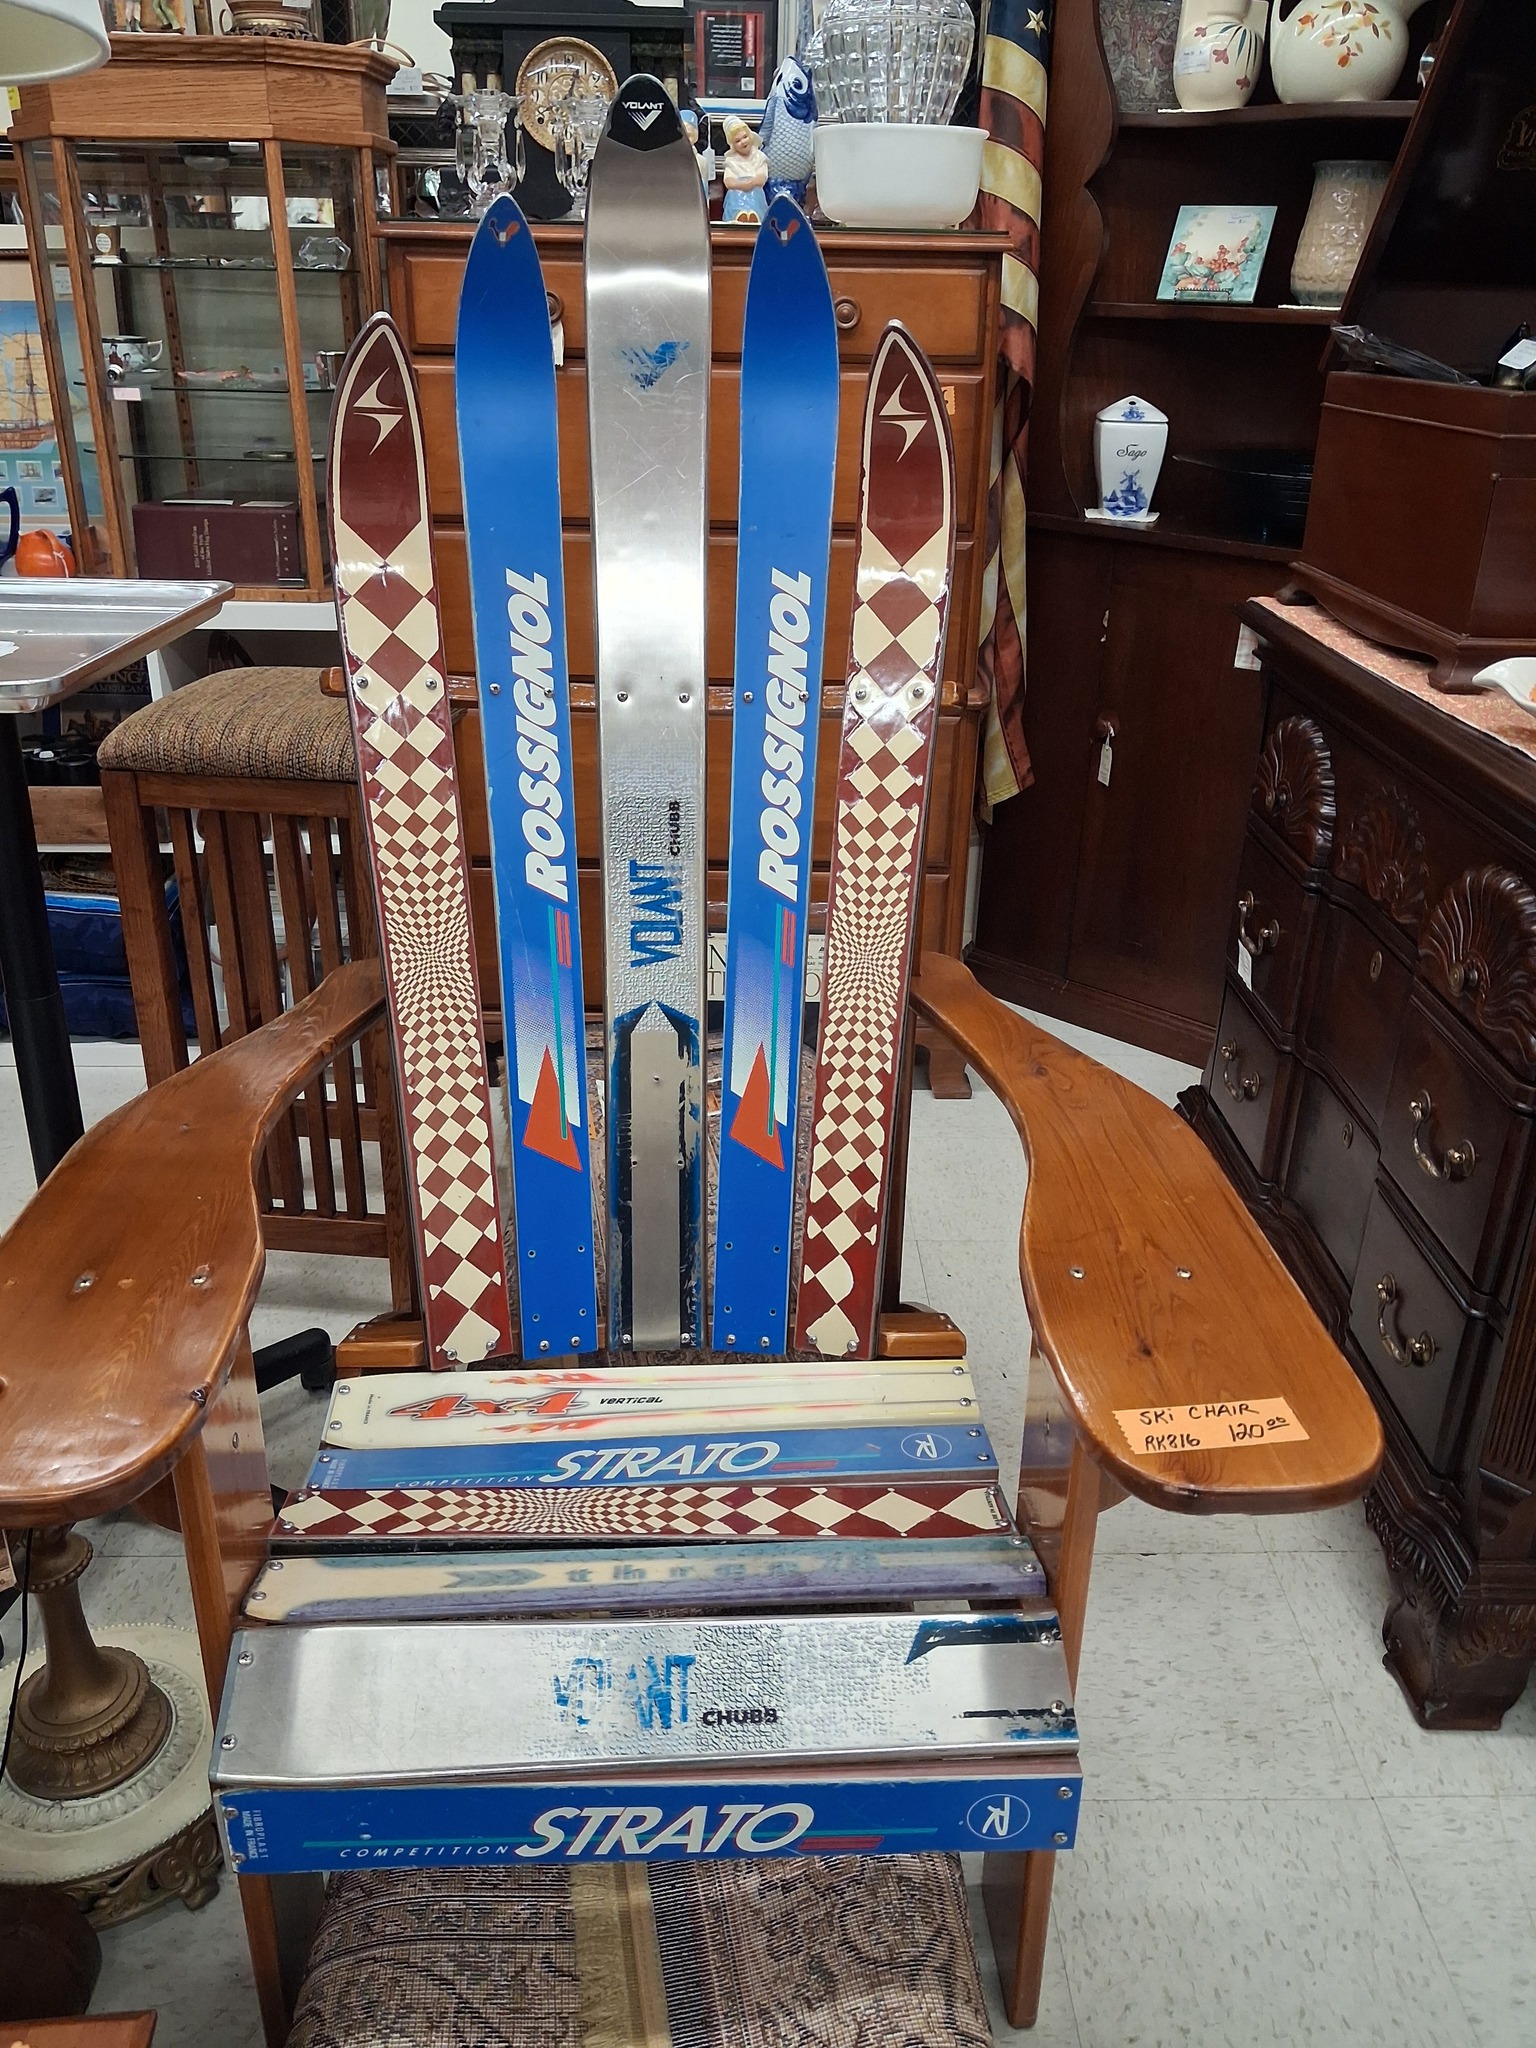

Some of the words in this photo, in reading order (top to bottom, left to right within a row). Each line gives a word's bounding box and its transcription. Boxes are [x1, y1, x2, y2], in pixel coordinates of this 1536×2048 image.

[621, 101, 665, 110] VOLANT
[1116, 443, 1148, 462] Sago
[505, 567, 569, 902] ROSSIGNOL
[758, 567, 812, 902] ROSSIGNOL
[669, 800, 682, 857] CHUBB
[387, 1390, 590, 1421] 4x4
[1189, 1403, 1260, 1420] CHAIR
[395, 1475, 535, 1488] COMPETITION
[538, 1440, 780, 1484] STRATO
[702, 1707, 779, 1726] CHUBB
[339, 1845, 510, 1858] COMPETITION
[515, 1801, 815, 1858] STRATO
